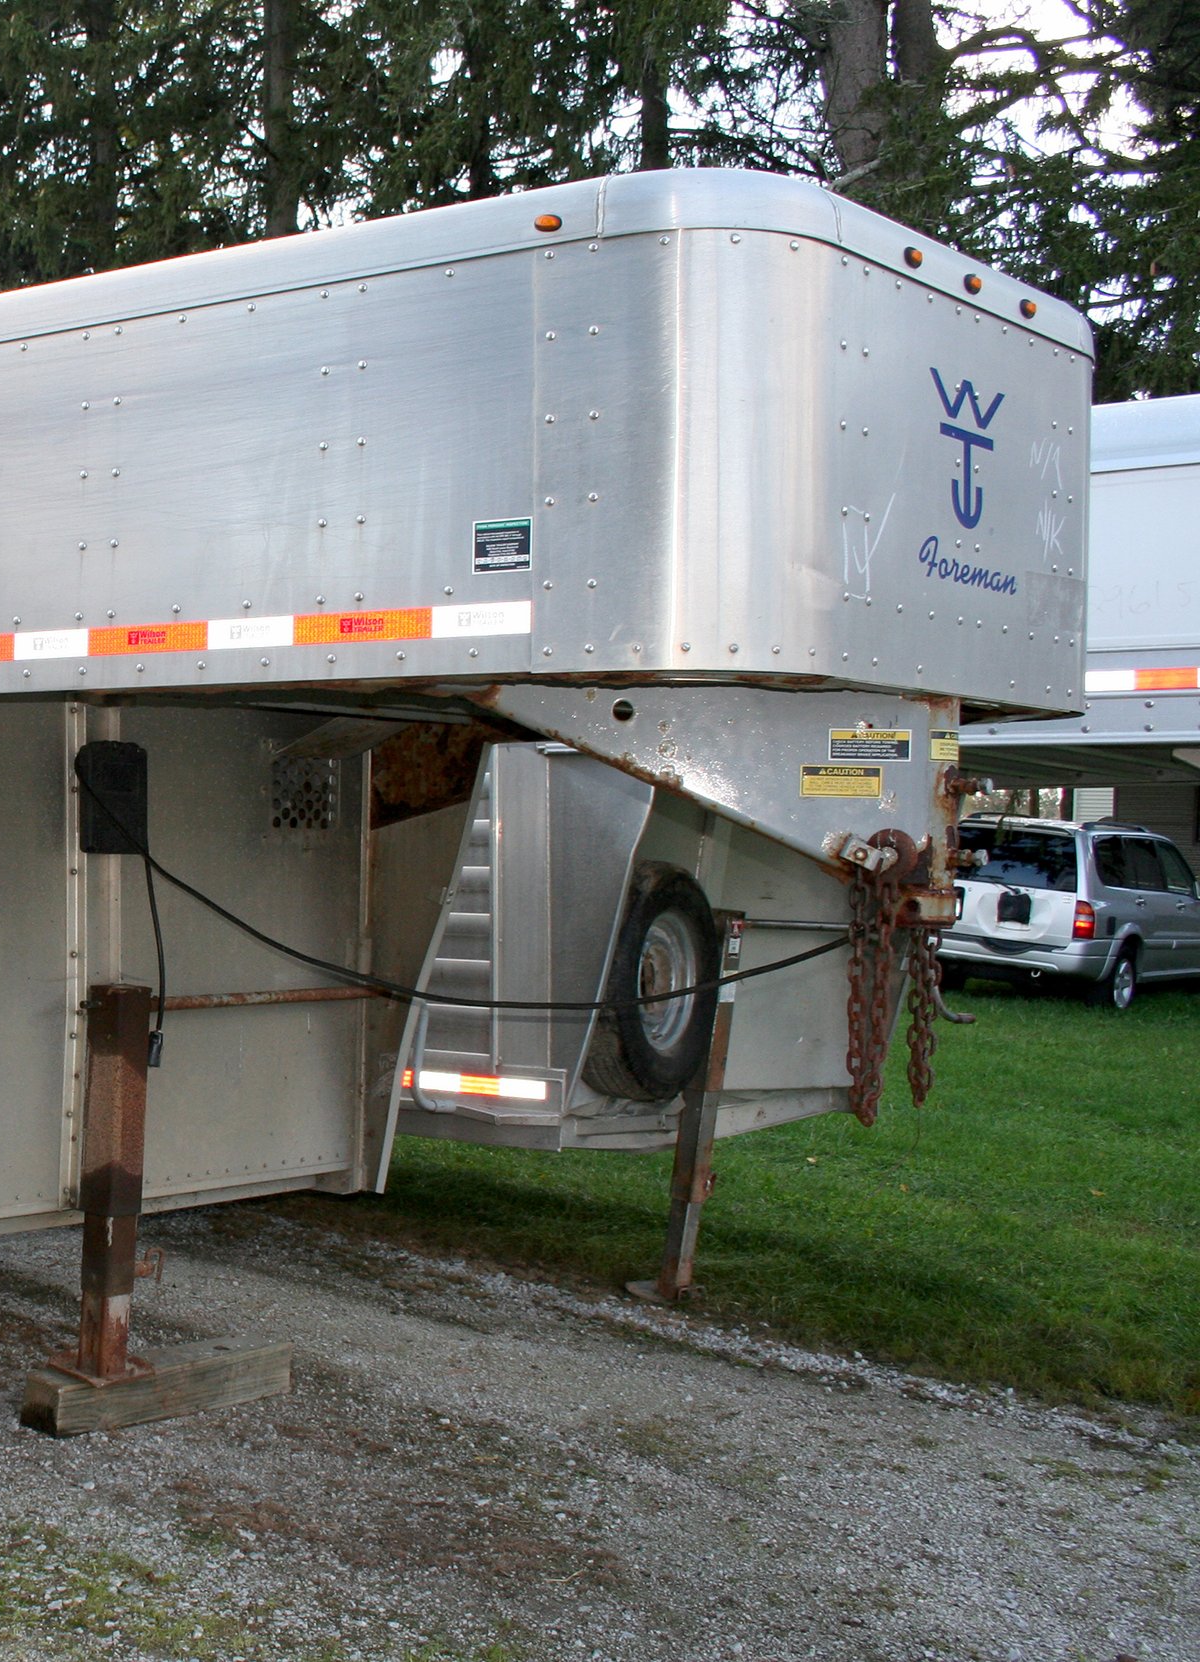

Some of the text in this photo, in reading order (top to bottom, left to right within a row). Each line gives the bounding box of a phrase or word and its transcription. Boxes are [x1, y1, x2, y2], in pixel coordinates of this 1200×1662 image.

[918, 535, 1017, 595] Foreman
[353, 617, 384, 626] Wilson
[139, 630, 166, 638] Wilson
[826, 768, 865, 776] CAUTION
